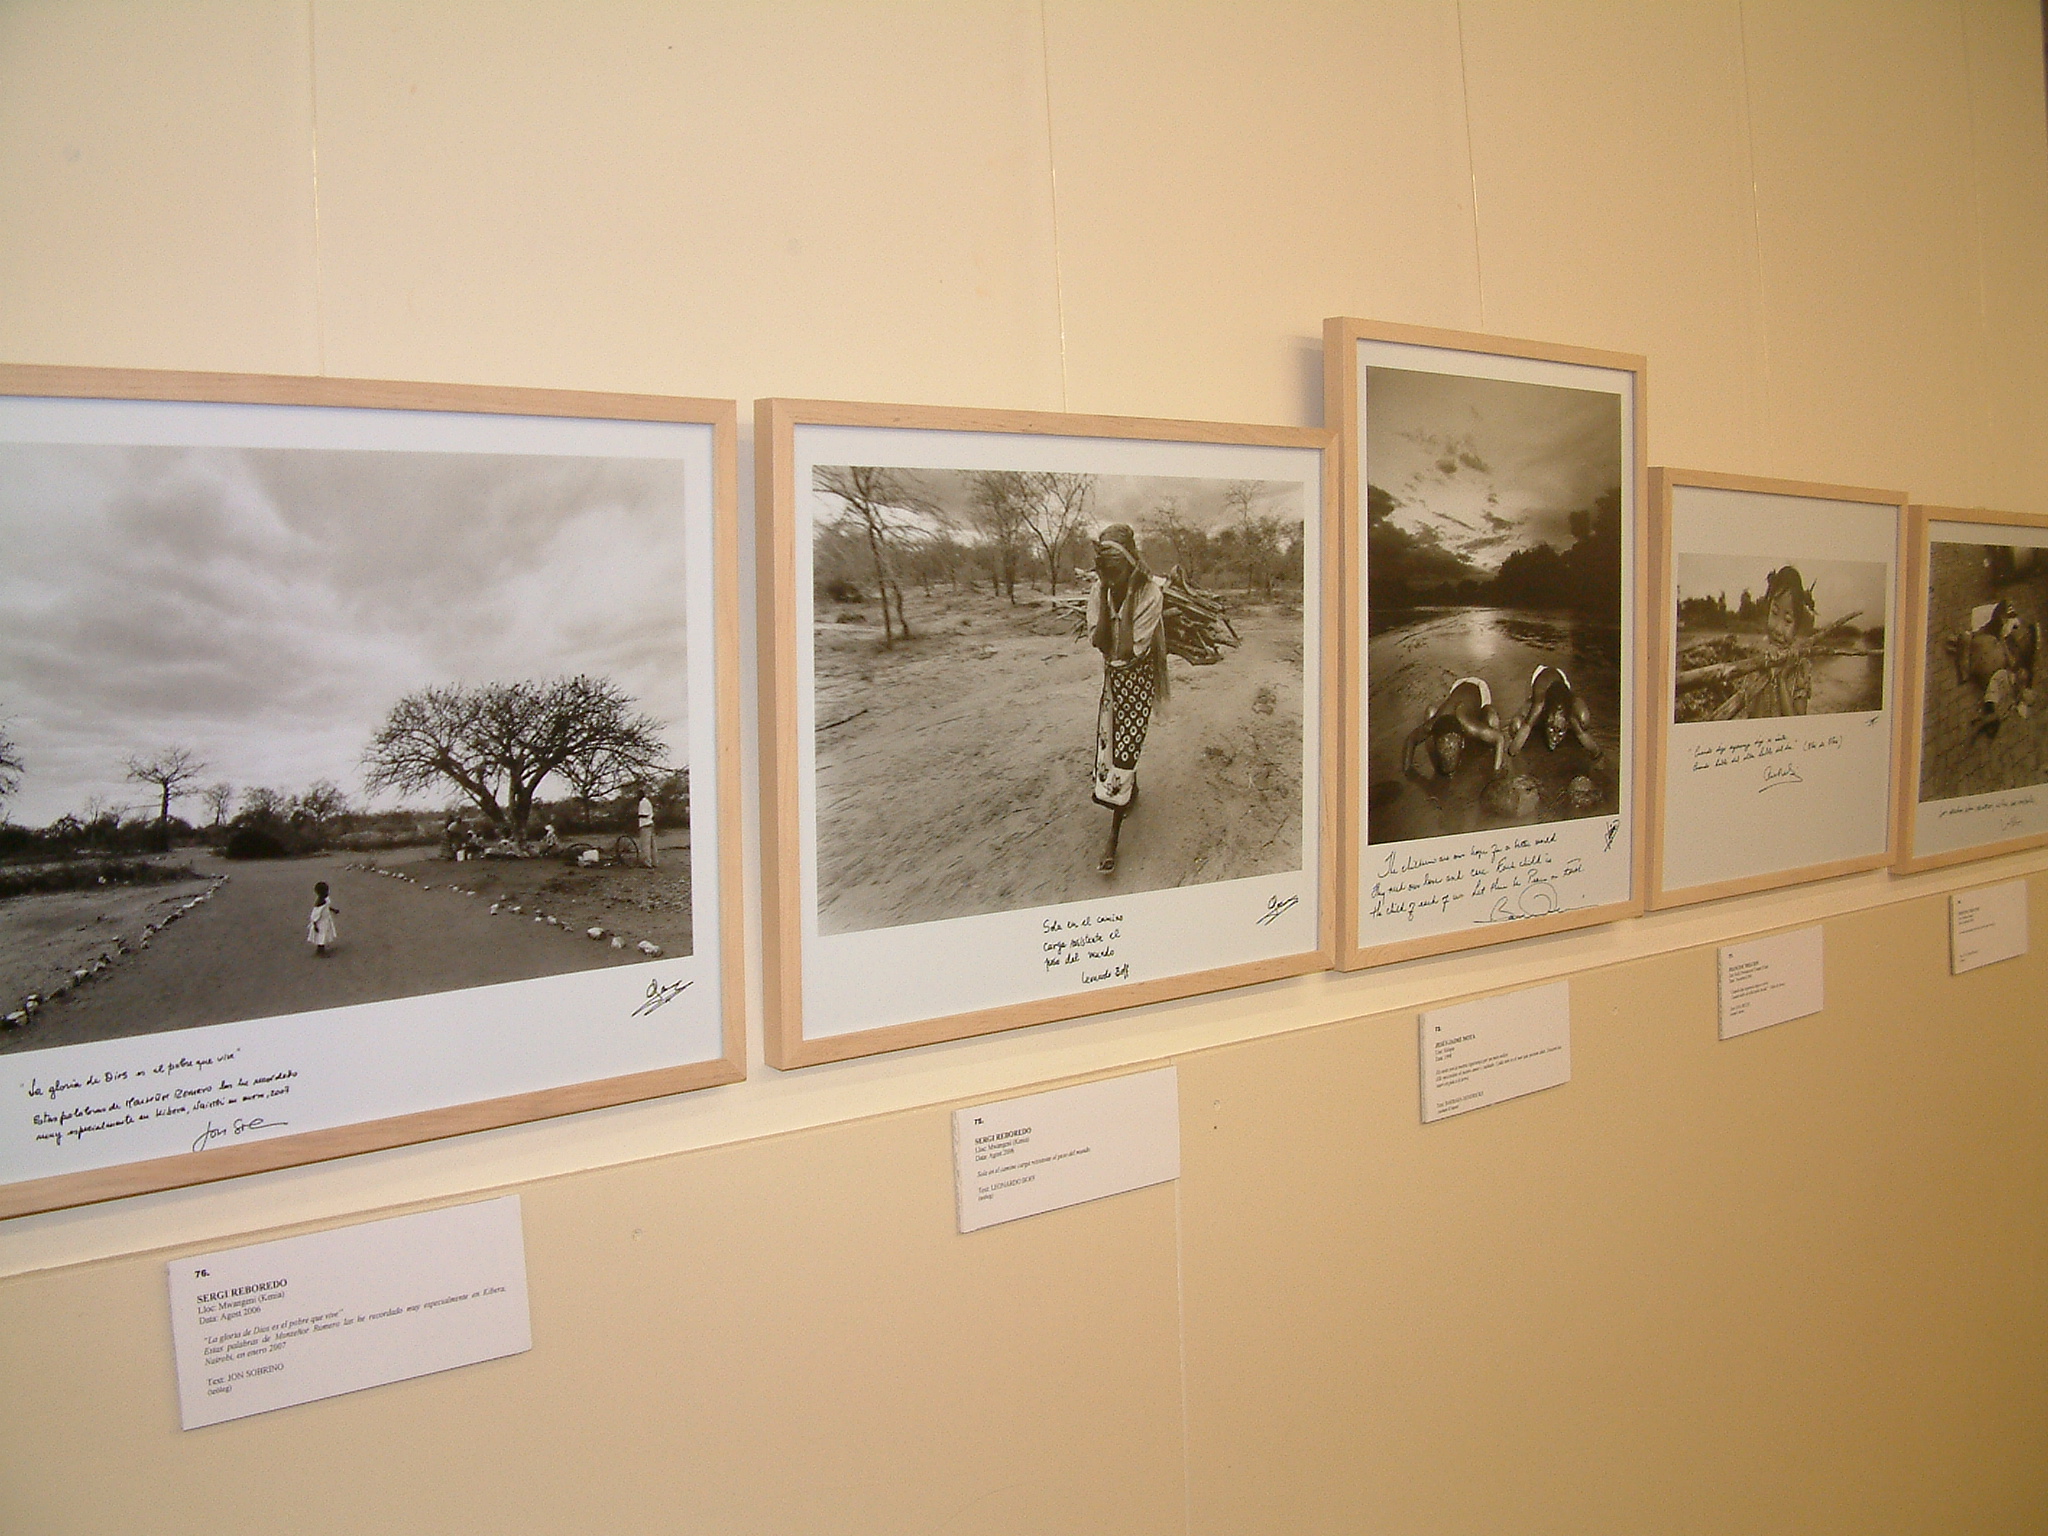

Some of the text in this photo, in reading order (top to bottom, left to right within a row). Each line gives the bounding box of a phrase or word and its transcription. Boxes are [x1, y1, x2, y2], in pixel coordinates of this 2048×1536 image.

[1081, 916, 1091, 926] el
[1097, 913, 1123, 923] camino
[1109, 928, 1121, 940] el
[48, 1079, 81, 1099] gloria
[86, 1075, 100, 1085] de
[104, 1071, 128, 1083] Dios
[153, 1064, 165, 1073] el
[168, 1057, 193, 1076] pobre
[196, 1058, 213, 1071] que
[108, 1102, 121, 1111] de
[174, 1085, 213, 1100] Romero
[194, 1269, 210, 1278] 76.
[197, 1278, 288, 1304] SERGI REBOREDO
[220, 1310, 242, 1321] Agost
[243, 1306, 262, 1316] 2006
[203, 1345, 224, 1356] Estas
[226, 1338, 259, 1352] palabras
[262, 1334, 271, 1343] de
[313, 1321, 340, 1332] Romero
[369, 1306, 403, 1321] recordado
[406, 1304, 421, 1312] muy
[219, 1331, 241, 1343] gloria
[242, 1328, 252, 1337] de
[253, 1325, 270, 1335] Dios
[271, 1323, 279, 1331] es
[281, 1320, 288, 1329] el
[289, 1317, 309, 1329] pobre
[310, 1314, 323, 1324] que
[236, 1351, 246, 1359] en
[247, 1347, 267, 1357] enero
[269, 1341, 287, 1353] 2007
[227, 1371, 244, 1382] JON
[245, 1363, 285, 1378] SOBRINO
